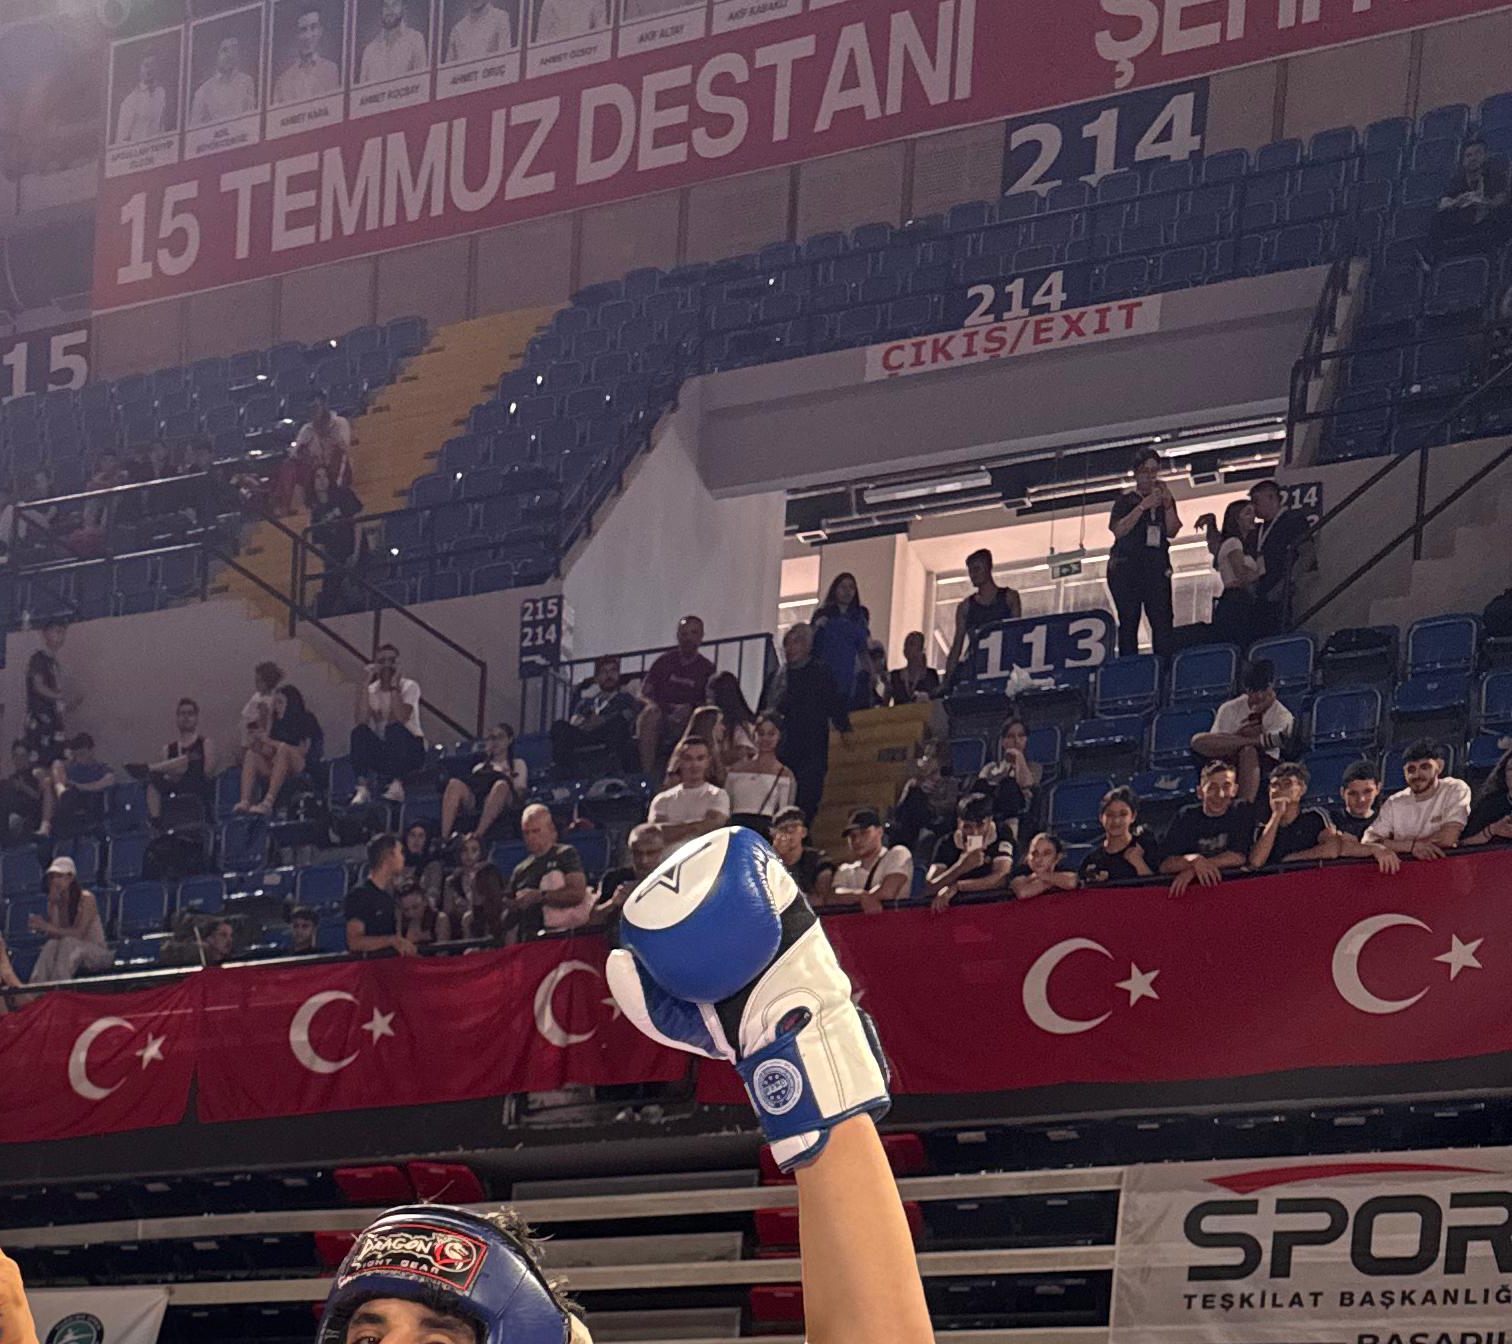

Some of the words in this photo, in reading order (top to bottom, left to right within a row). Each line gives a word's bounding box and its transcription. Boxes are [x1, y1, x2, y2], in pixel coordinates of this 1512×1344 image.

[116, 180, 201, 286] 15
[219, 96, 561, 260] TEMMUZ
[575, 0, 976, 186] DESTANI
[1004, 92, 1203, 198] 214
[963, 271, 1068, 328] 214
[881, 301, 1144, 377] ÇIKIŞ/EXIT
[521, 624, 557, 648] 214
[523, 598, 559, 622] 215
[976, 617, 1107, 681] 113
[355, 1237, 434, 1263] DRAGON
[1183, 1190, 1512, 1282] SPOR
[1183, 1290, 1324, 1312] TEŞKİLAT
